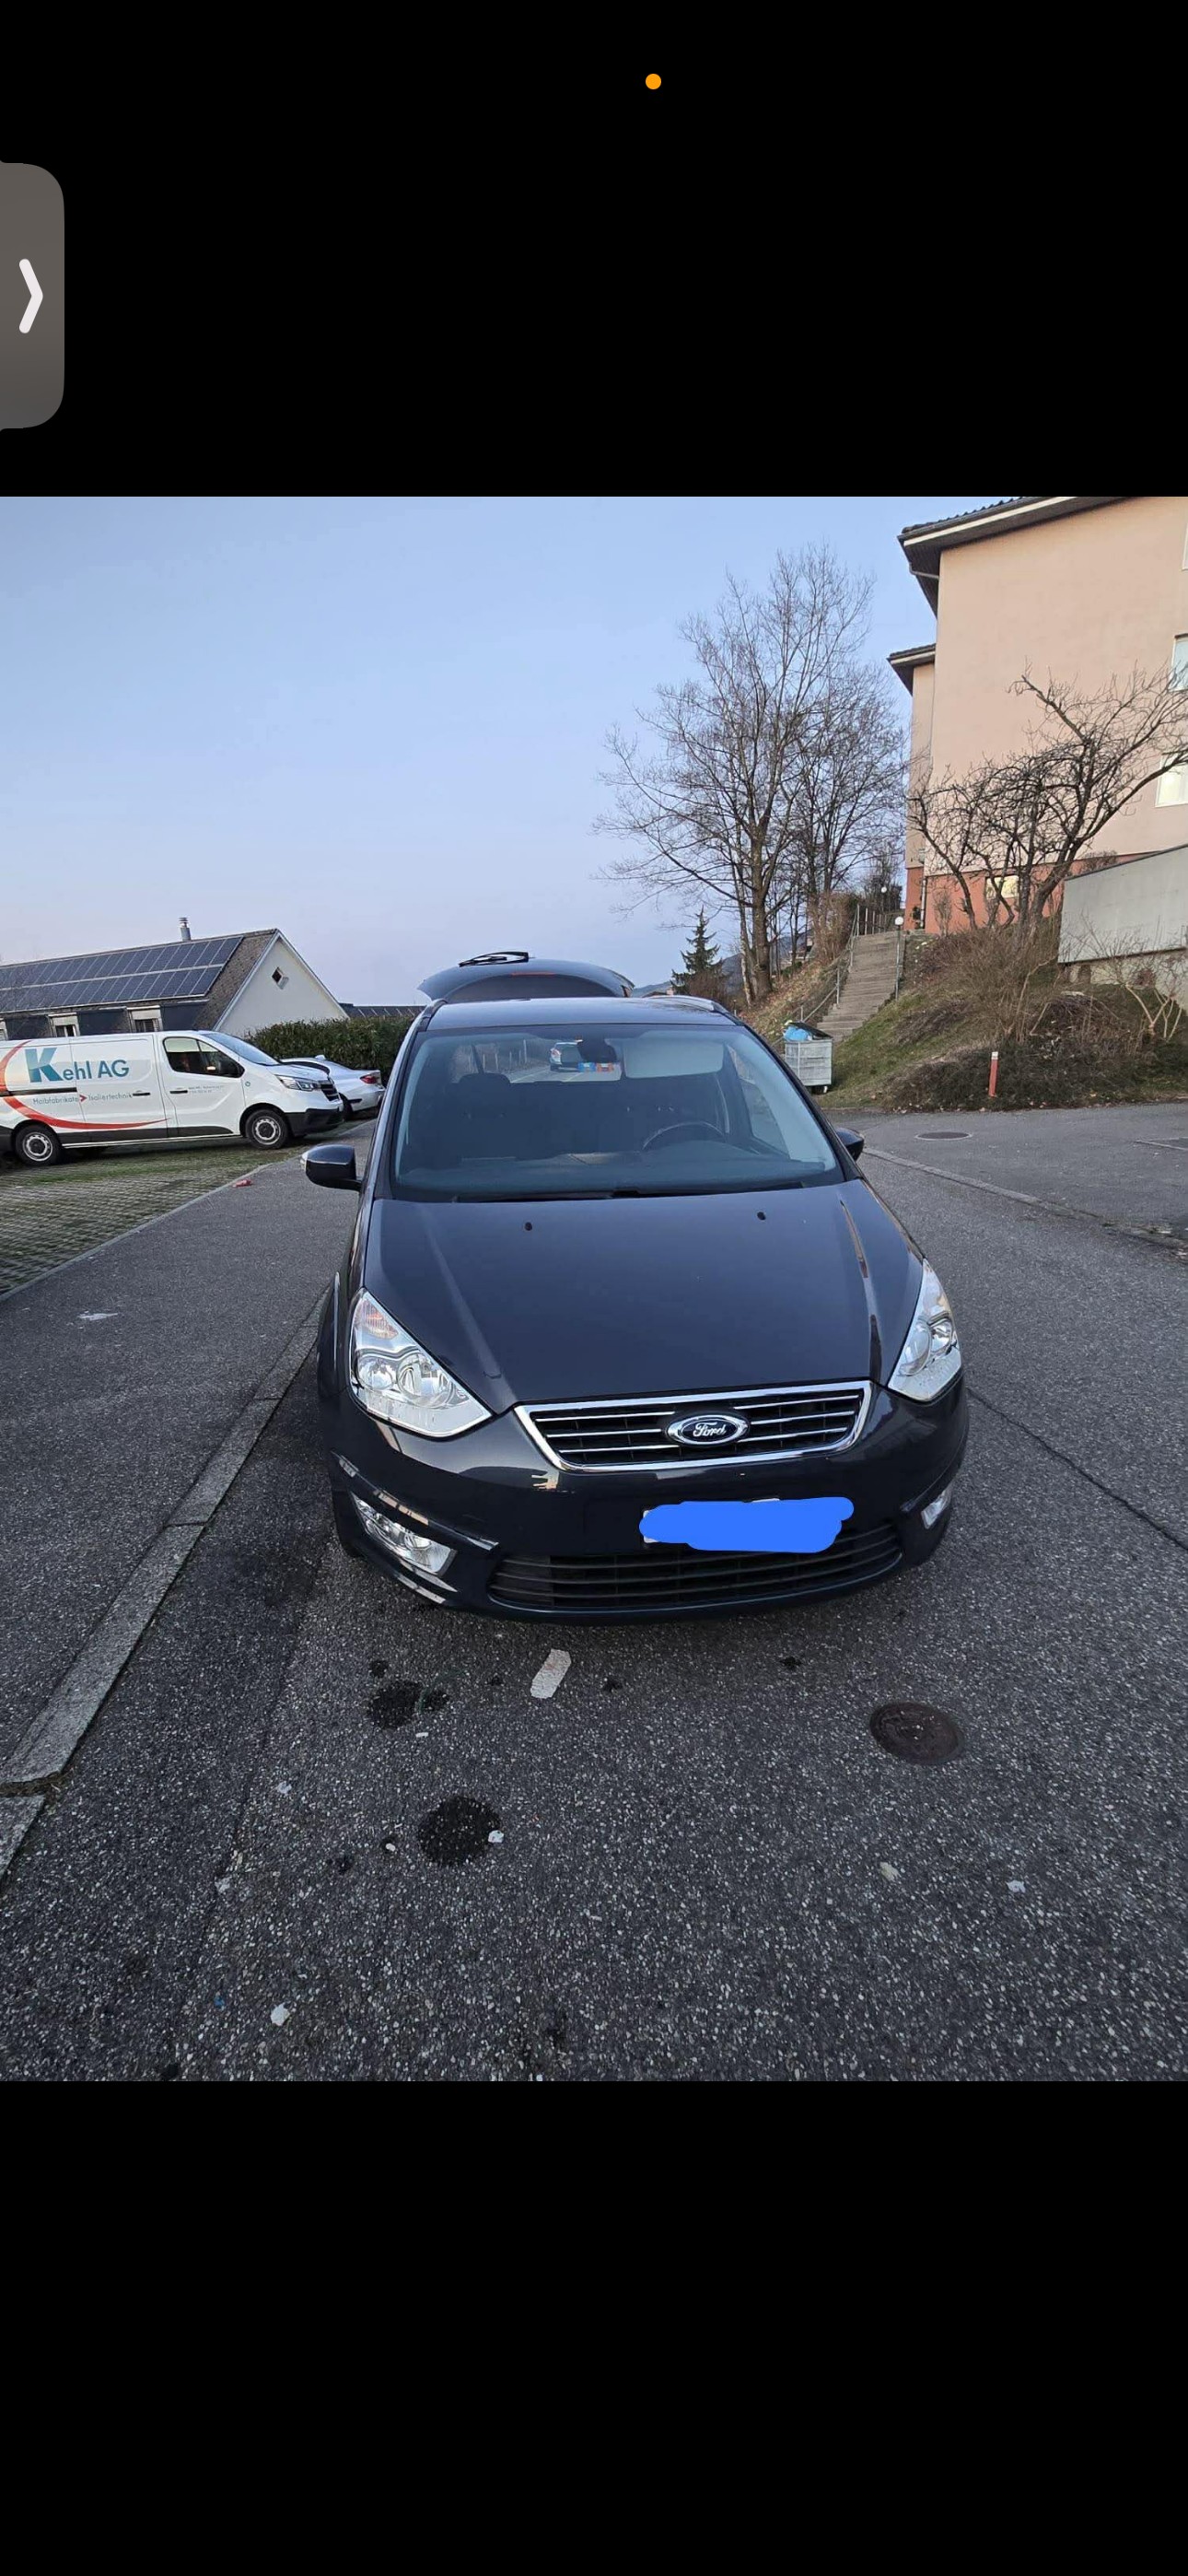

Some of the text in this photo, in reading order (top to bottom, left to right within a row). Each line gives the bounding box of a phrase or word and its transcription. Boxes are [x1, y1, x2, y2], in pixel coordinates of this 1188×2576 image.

[25, 1047, 130, 1083] Kehl AG
[693, 1422, 727, 1437] Ford
